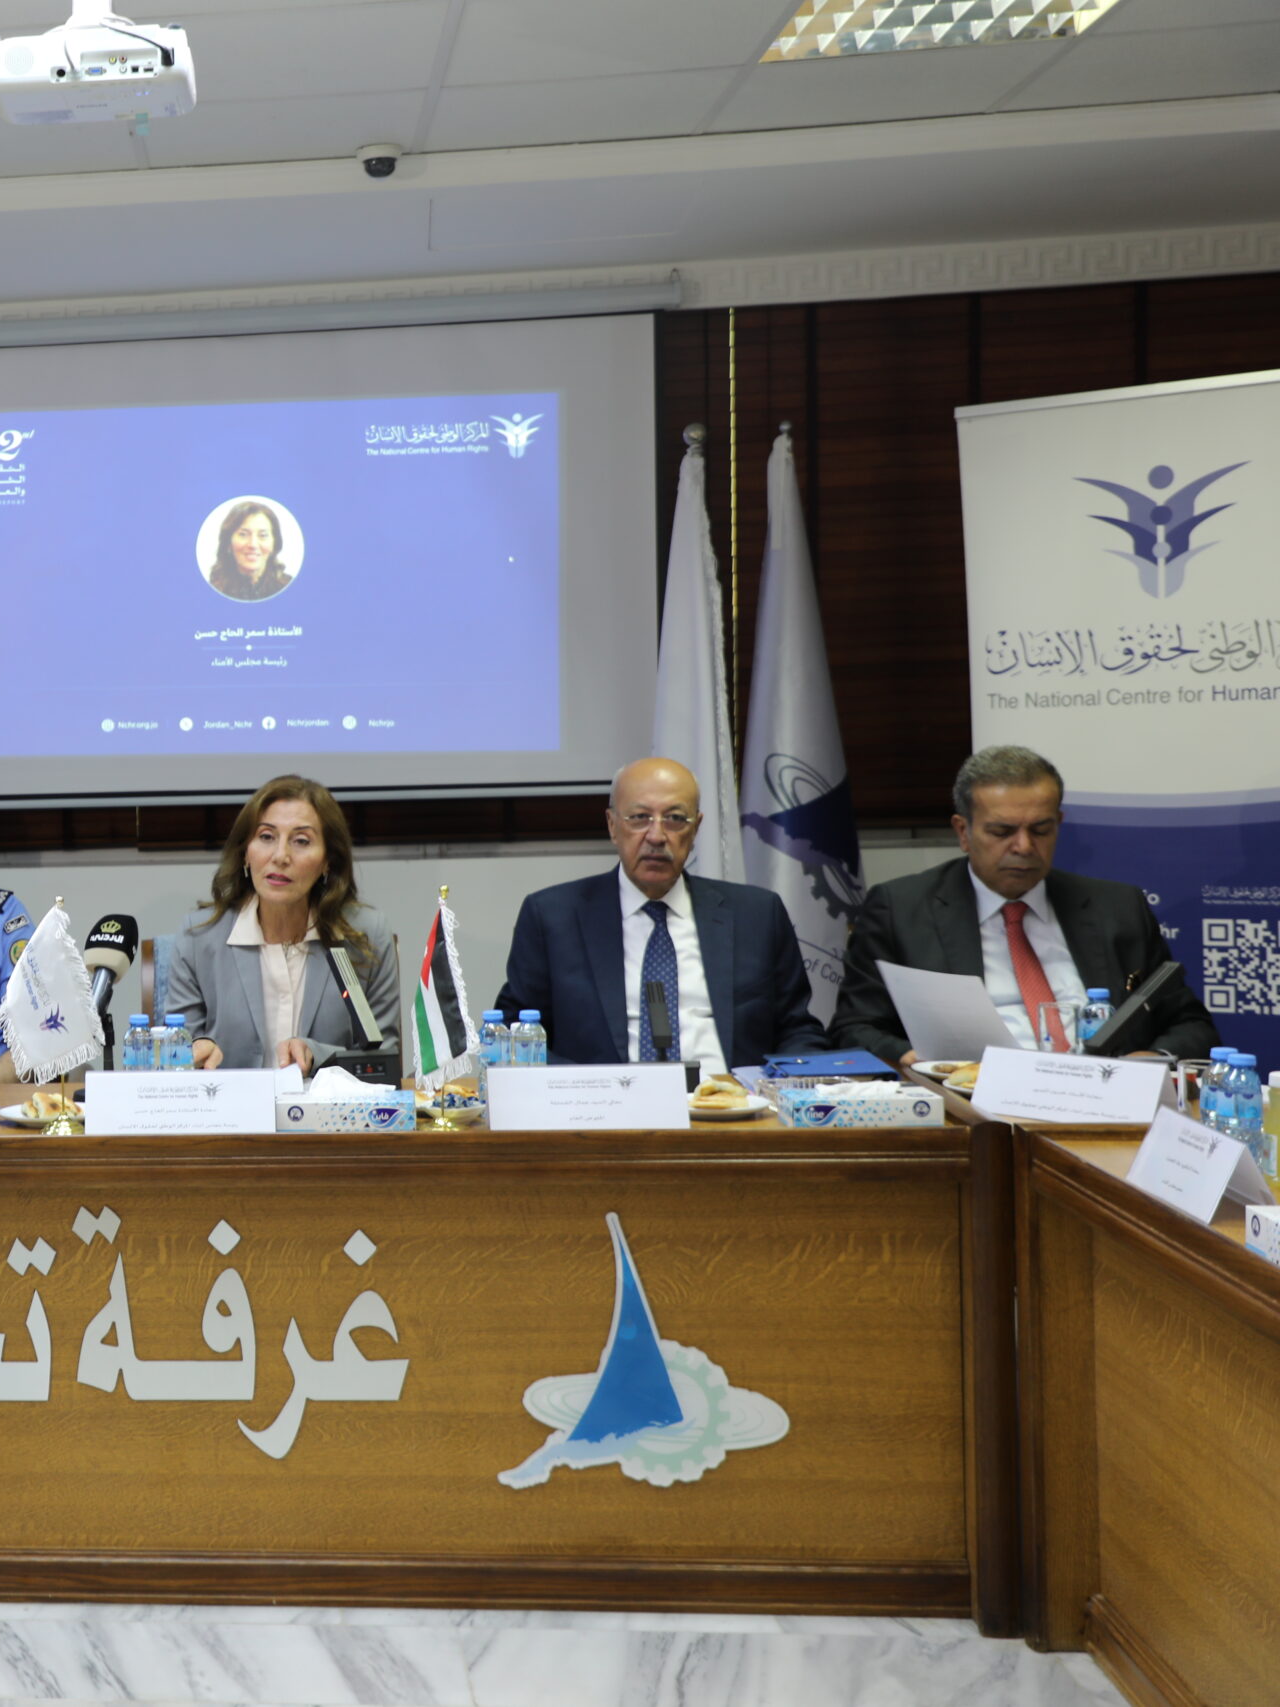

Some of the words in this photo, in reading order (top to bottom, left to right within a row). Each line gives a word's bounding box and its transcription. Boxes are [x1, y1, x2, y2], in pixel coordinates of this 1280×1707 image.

[987, 692, 1018, 709] The
[1024, 690, 1102, 708] National
[1106, 688, 1171, 706] Centre
[1178, 686, 1204, 703] for
[72, 1205, 410, 1459] غرفة
